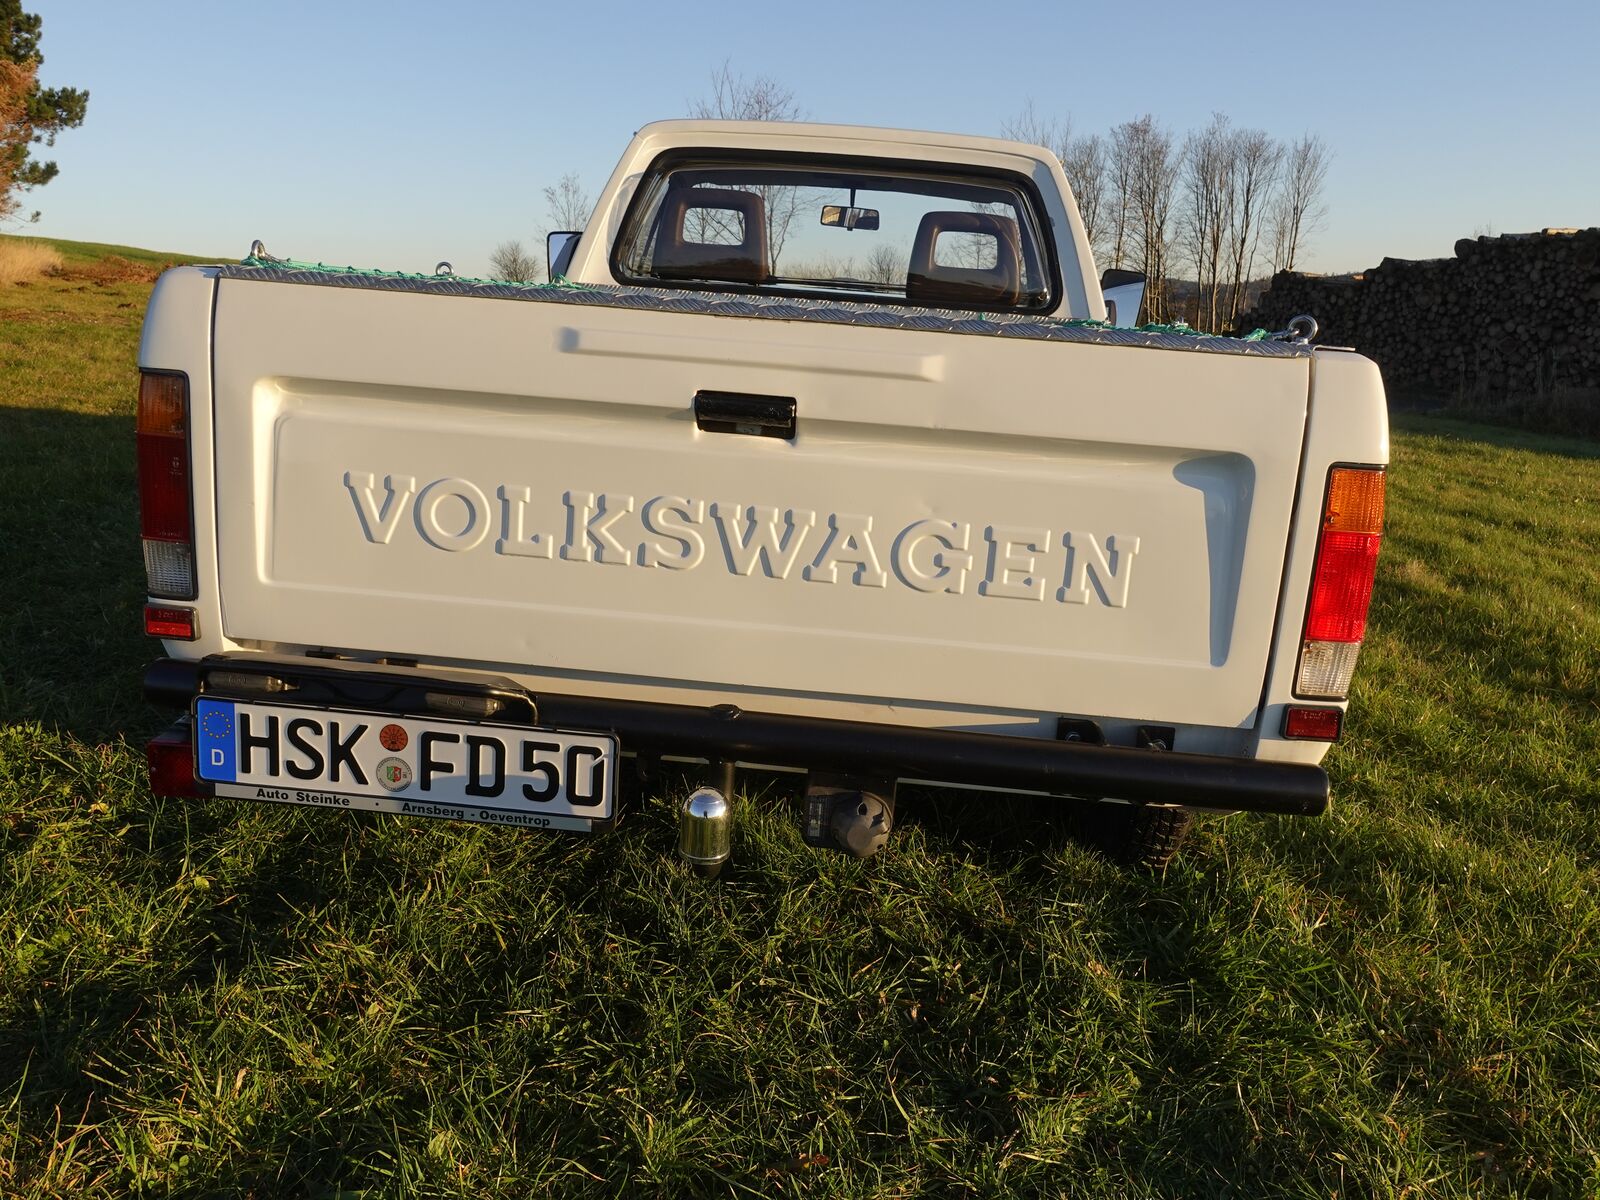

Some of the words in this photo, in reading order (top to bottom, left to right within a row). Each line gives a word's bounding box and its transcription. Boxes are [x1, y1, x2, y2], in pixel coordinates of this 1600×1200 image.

[344, 470, 1141, 608] VOLKSWAGEN
[211, 749, 225, 766] D
[239, 713, 369, 785] HSK
[419, 731, 506, 798] FD
[522, 741, 604, 807] 50
[256, 788, 288, 802] Auto
[296, 792, 350, 807] Steinke
[402, 802, 464, 820] Arnsberg
[479, 810, 550, 829] Oeventrop
